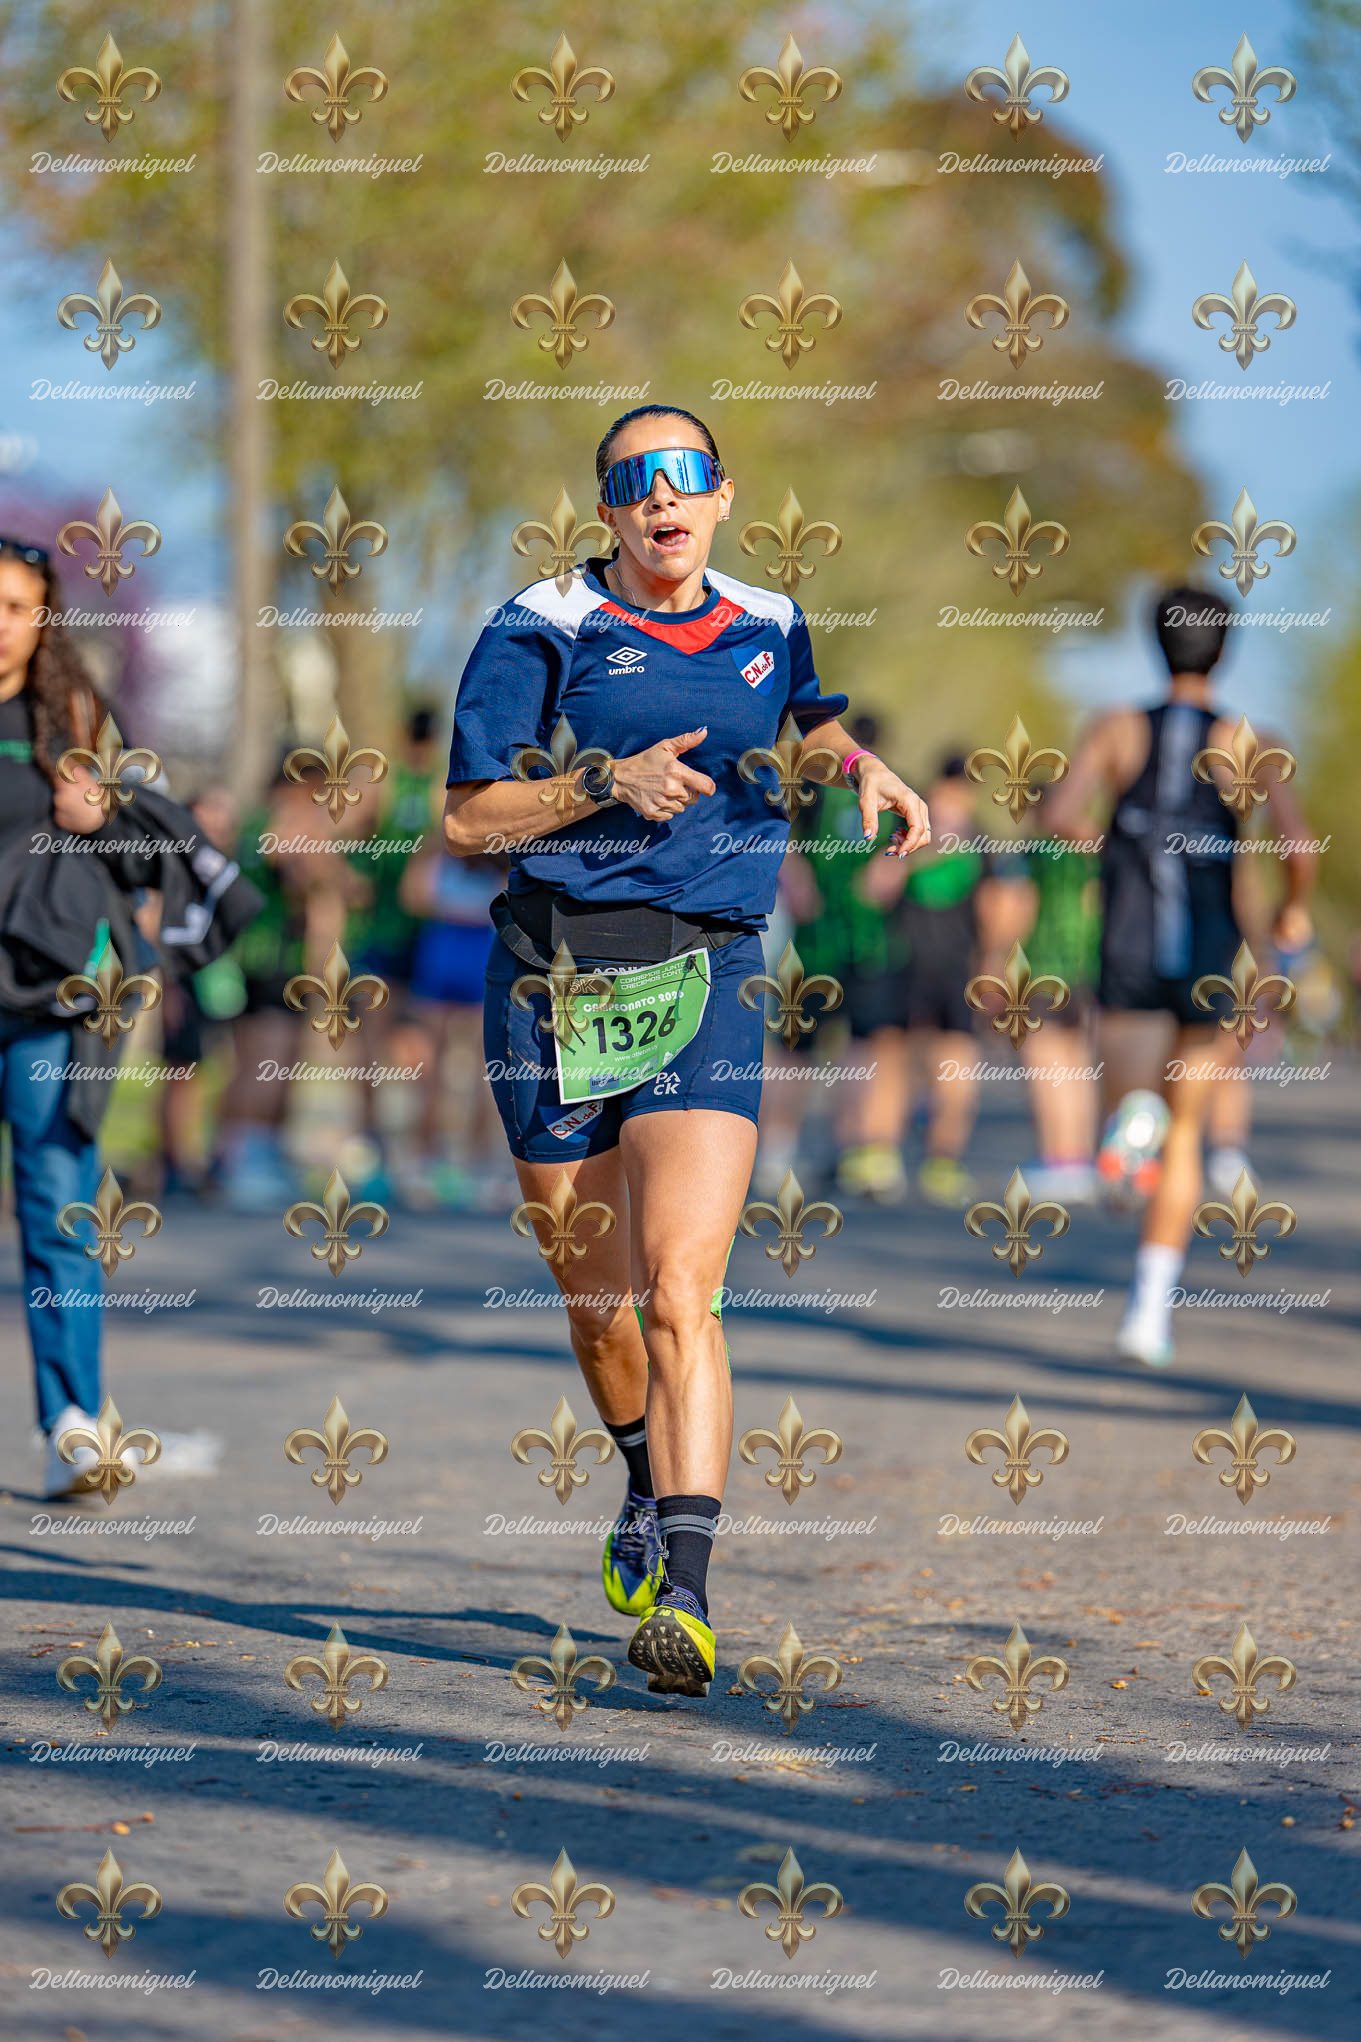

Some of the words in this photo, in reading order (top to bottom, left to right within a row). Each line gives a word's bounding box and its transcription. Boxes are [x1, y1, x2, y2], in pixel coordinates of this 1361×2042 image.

[608, 664, 645, 676] umbro
[569, 978, 599, 994] 5K
[583, 996, 656, 1012] CAMPEONATO
[591, 1004, 677, 1054] 1326
